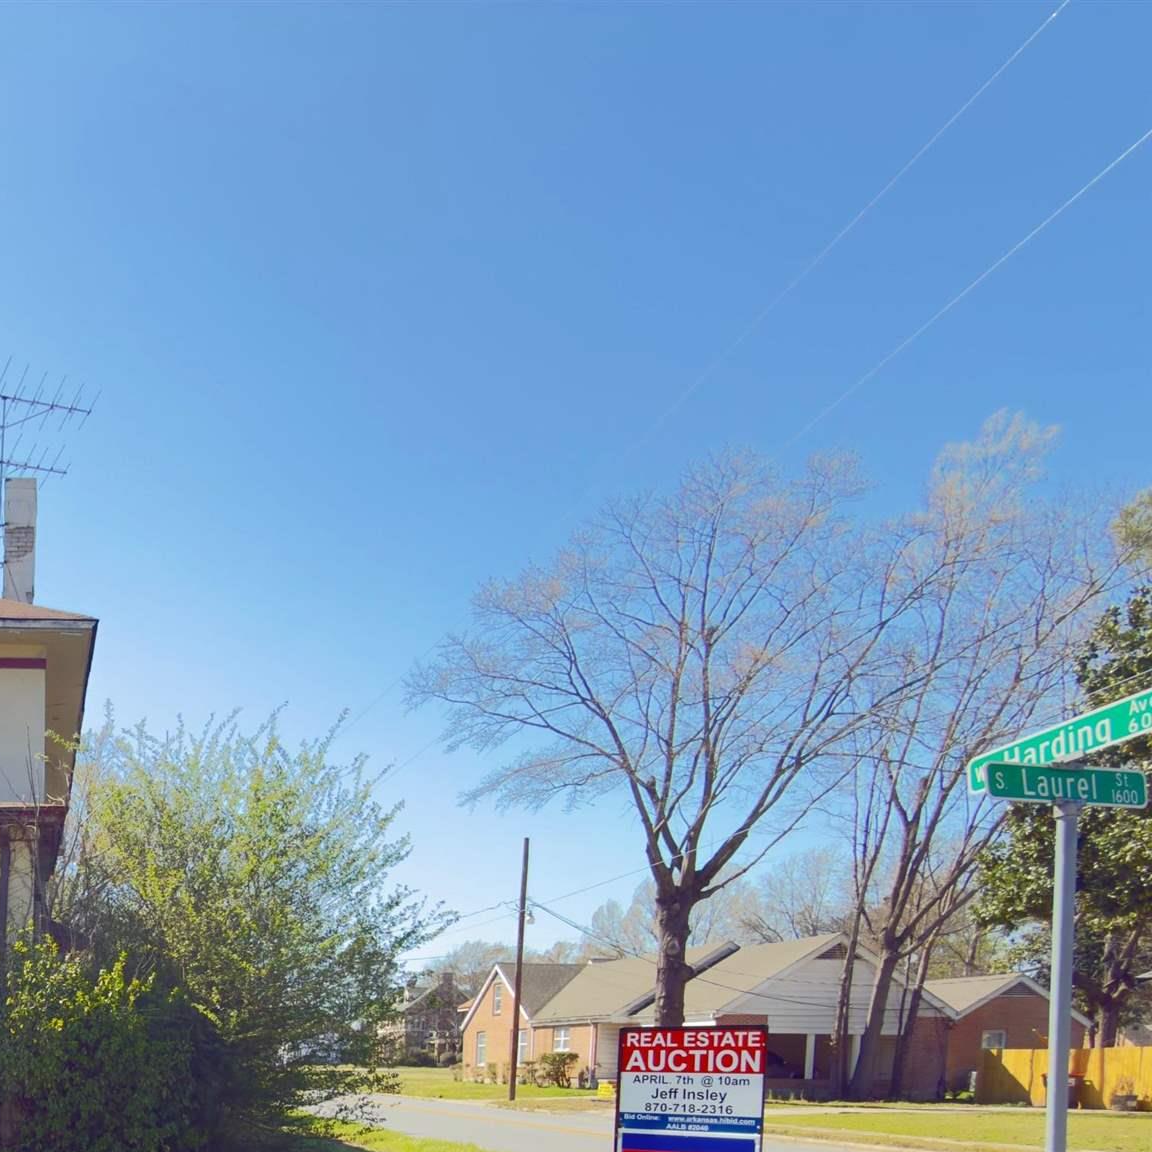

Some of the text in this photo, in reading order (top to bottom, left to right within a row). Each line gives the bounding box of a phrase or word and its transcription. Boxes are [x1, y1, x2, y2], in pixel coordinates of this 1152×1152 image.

[1003, 718, 1111, 764] Harding
[1129, 696, 1152, 717] Av
[1021, 768, 1097, 800] Laurel
[1115, 774, 1129, 787] St
[1112, 789, 1138, 804] 1600
[626, 1031, 761, 1048] REAL ESTATE
[625, 1049, 761, 1073] AUCTION
[676, 1075, 694, 1086] 7th
[701, 1075, 714, 1088] @
[719, 1076, 750, 1086] 10am
[651, 1088, 727, 1104] Jeff Insley
[644, 1102, 734, 1115] 870-718-2316
